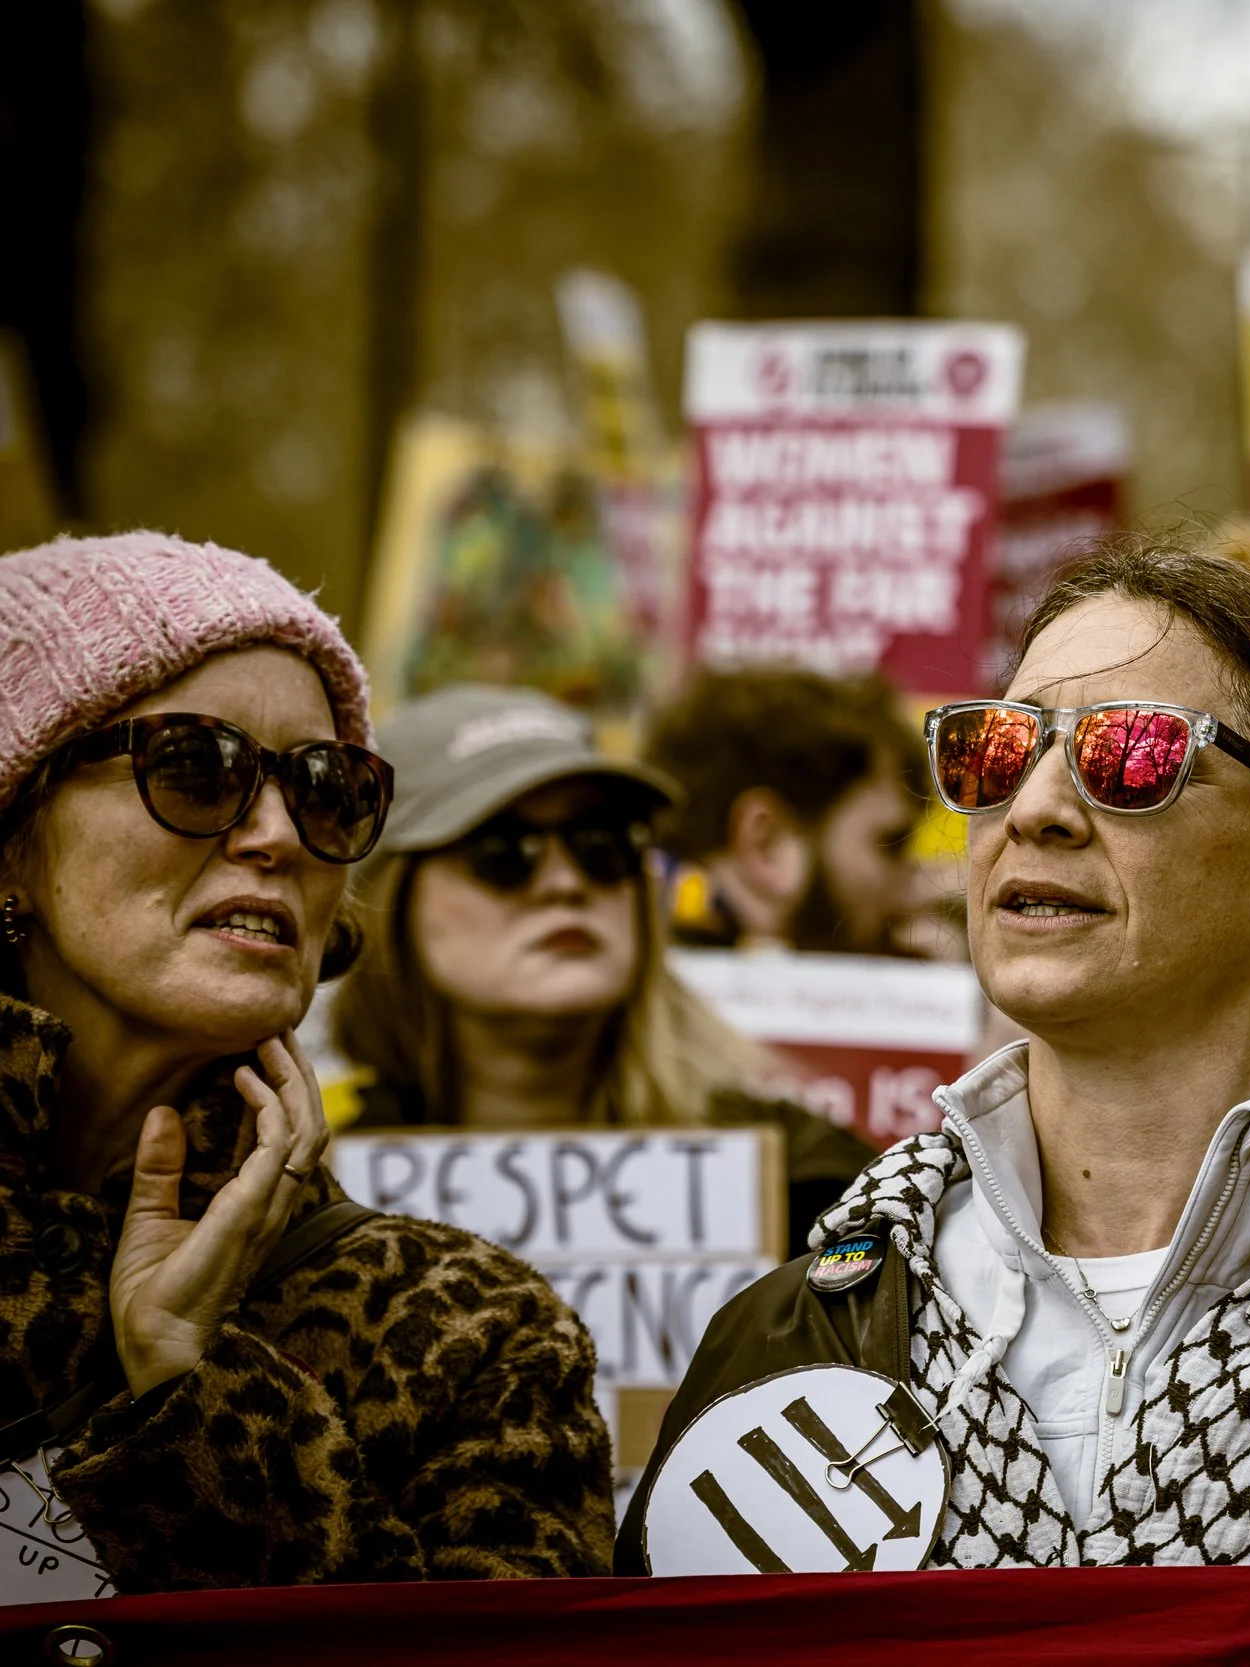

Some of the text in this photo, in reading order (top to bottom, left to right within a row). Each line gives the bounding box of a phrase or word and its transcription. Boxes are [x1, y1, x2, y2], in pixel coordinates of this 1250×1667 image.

[824, 1240, 874, 1257] STAND
[819, 1251, 866, 1266] UP TO
[814, 1259, 874, 1277] RACISM
[18, 1545, 60, 1575] UP
